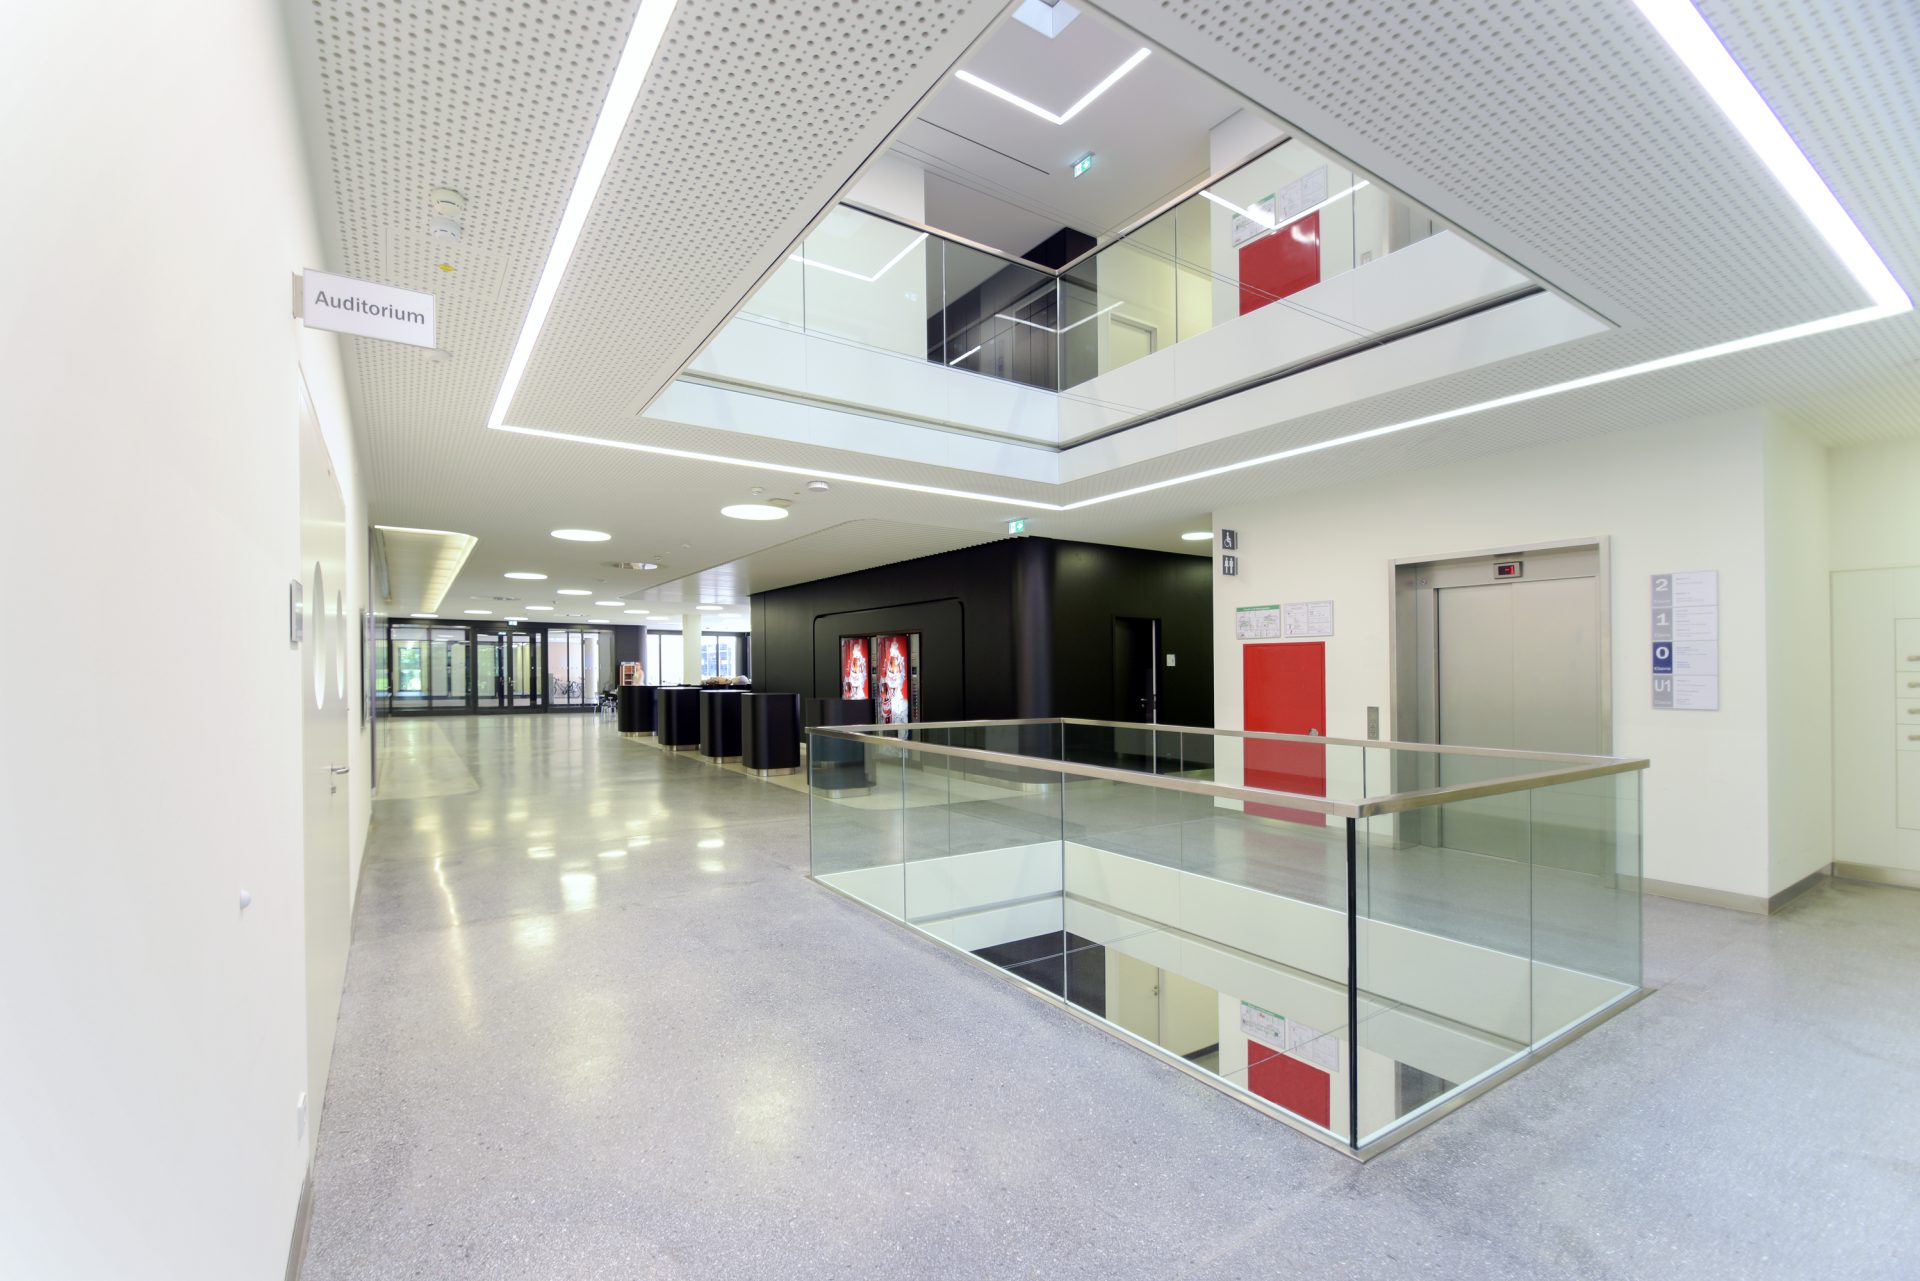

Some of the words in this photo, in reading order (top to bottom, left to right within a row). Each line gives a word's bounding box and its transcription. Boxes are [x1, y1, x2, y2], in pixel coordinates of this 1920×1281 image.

[315, 290, 425, 325] Auditorium
[1655, 578, 1669, 592] 2
[1655, 612, 1670, 626] 1
[1655, 679, 1671, 692] U1
